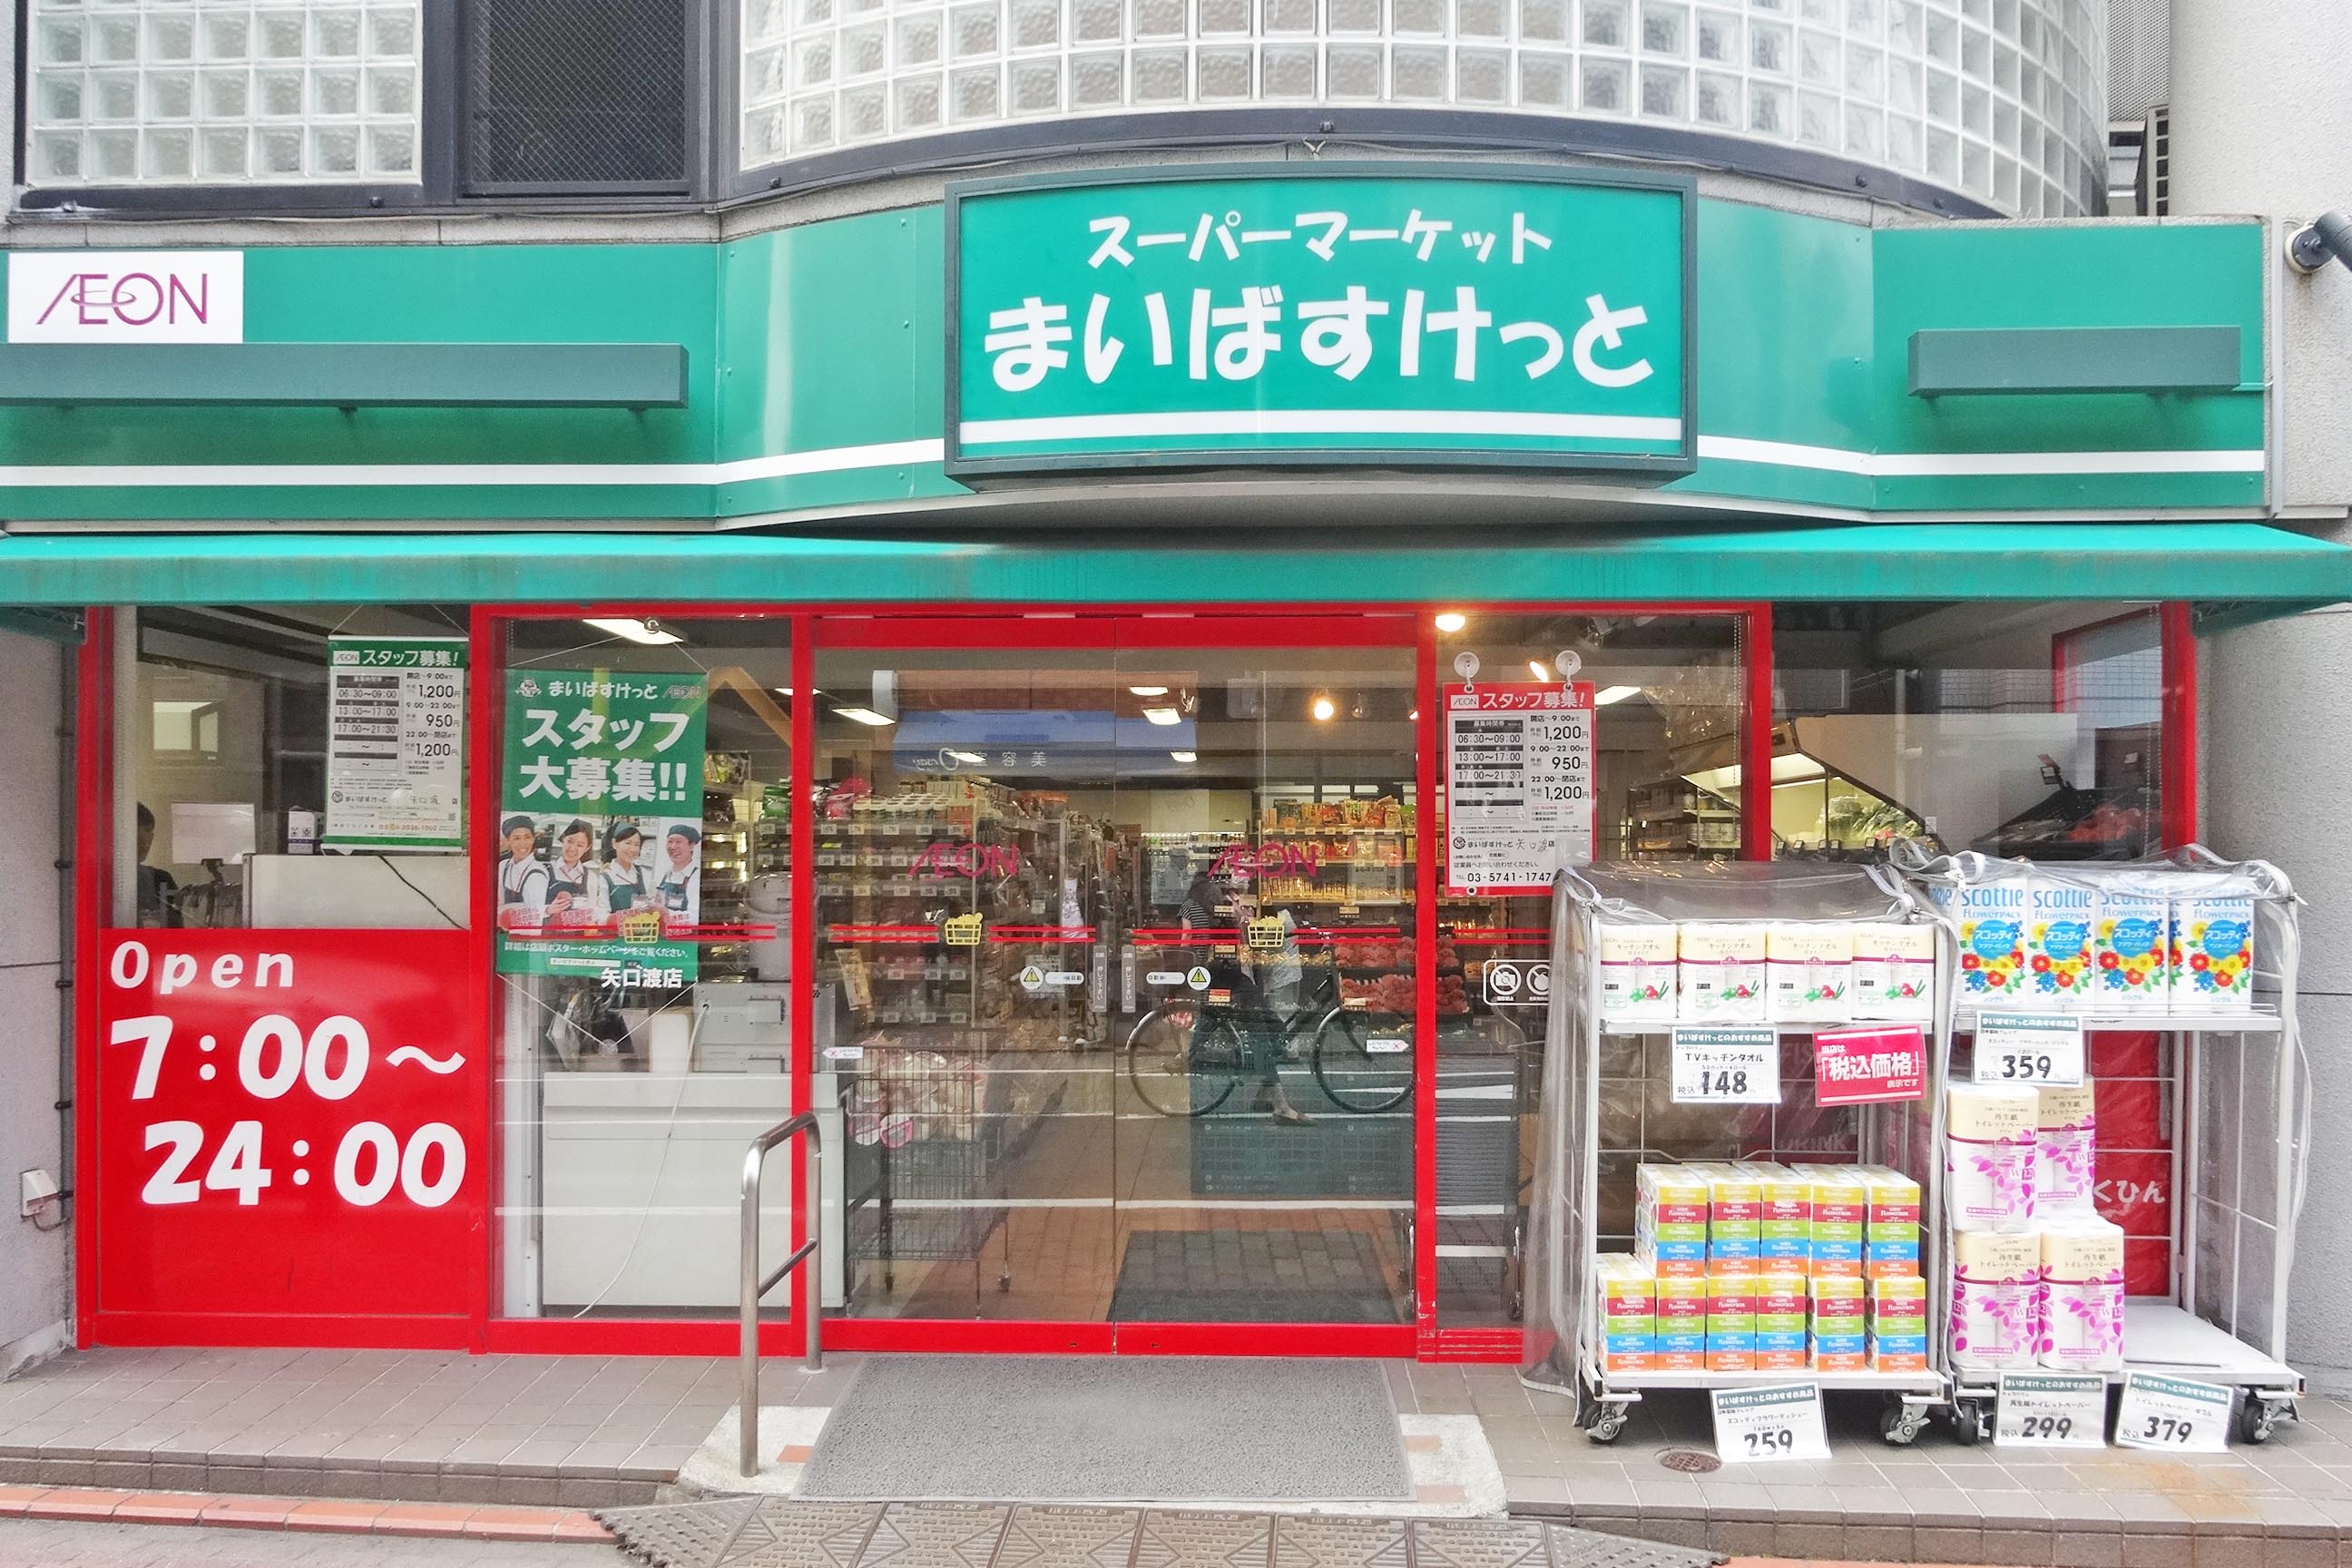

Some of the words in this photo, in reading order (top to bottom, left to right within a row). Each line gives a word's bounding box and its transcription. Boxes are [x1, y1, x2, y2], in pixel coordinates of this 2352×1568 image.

[1087, 208, 1553, 270] スーパーマーケット
[983, 284, 1655, 392] まいばすけっと
[548, 681, 658, 700] まいばすけっと
[522, 708, 691, 752] スタッフ
[110, 941, 294, 995] Open
[601, 967, 683, 988] 矢口渡店
[1821, 1044, 1847, 1054] 当店は
[2002, 1054, 2052, 1079] 359
[1702, 1071, 1748, 1094] 148
[1886, 1078, 1919, 1088] 表示です
[141, 1120, 466, 1208] 24:00
[2022, 1416, 2073, 1439] 299
[2143, 1416, 2192, 1444] 379
[1744, 1429, 1793, 1456] 259
